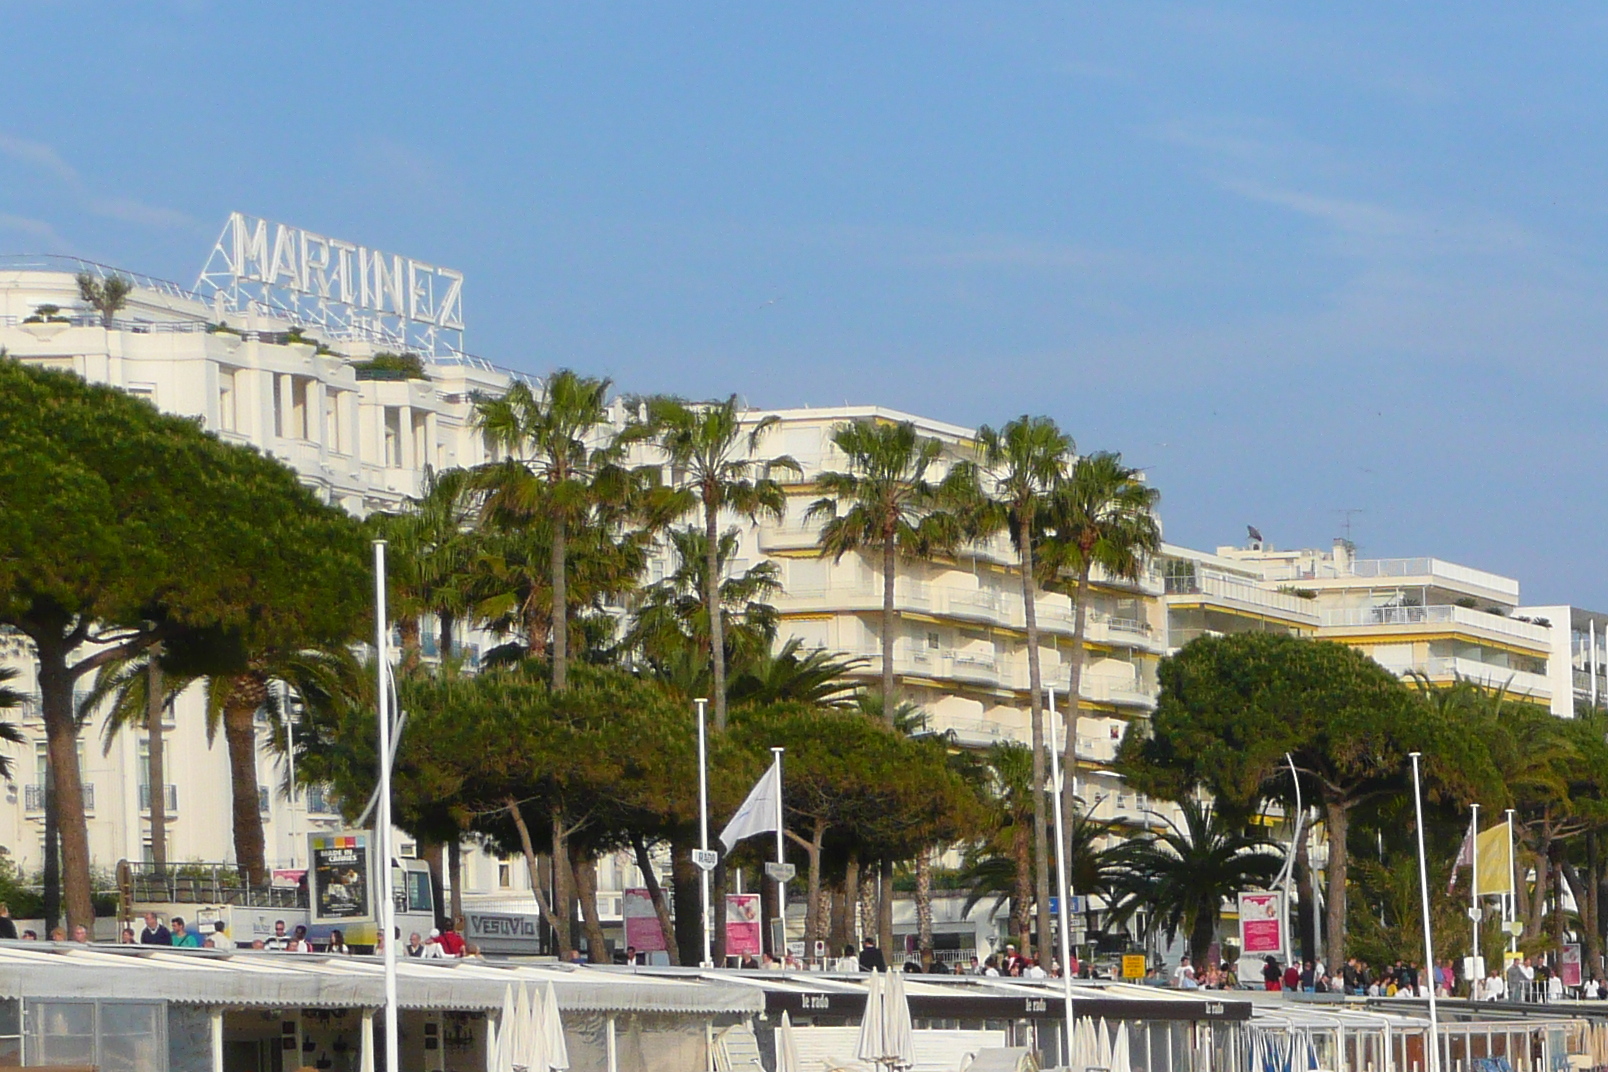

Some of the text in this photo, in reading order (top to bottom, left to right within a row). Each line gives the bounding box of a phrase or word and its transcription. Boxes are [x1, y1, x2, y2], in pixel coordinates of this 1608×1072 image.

[230, 212, 465, 331] MARTINEZ
[802, 993, 829, 1009] le rado
[1033, 997, 1047, 1012] rado
